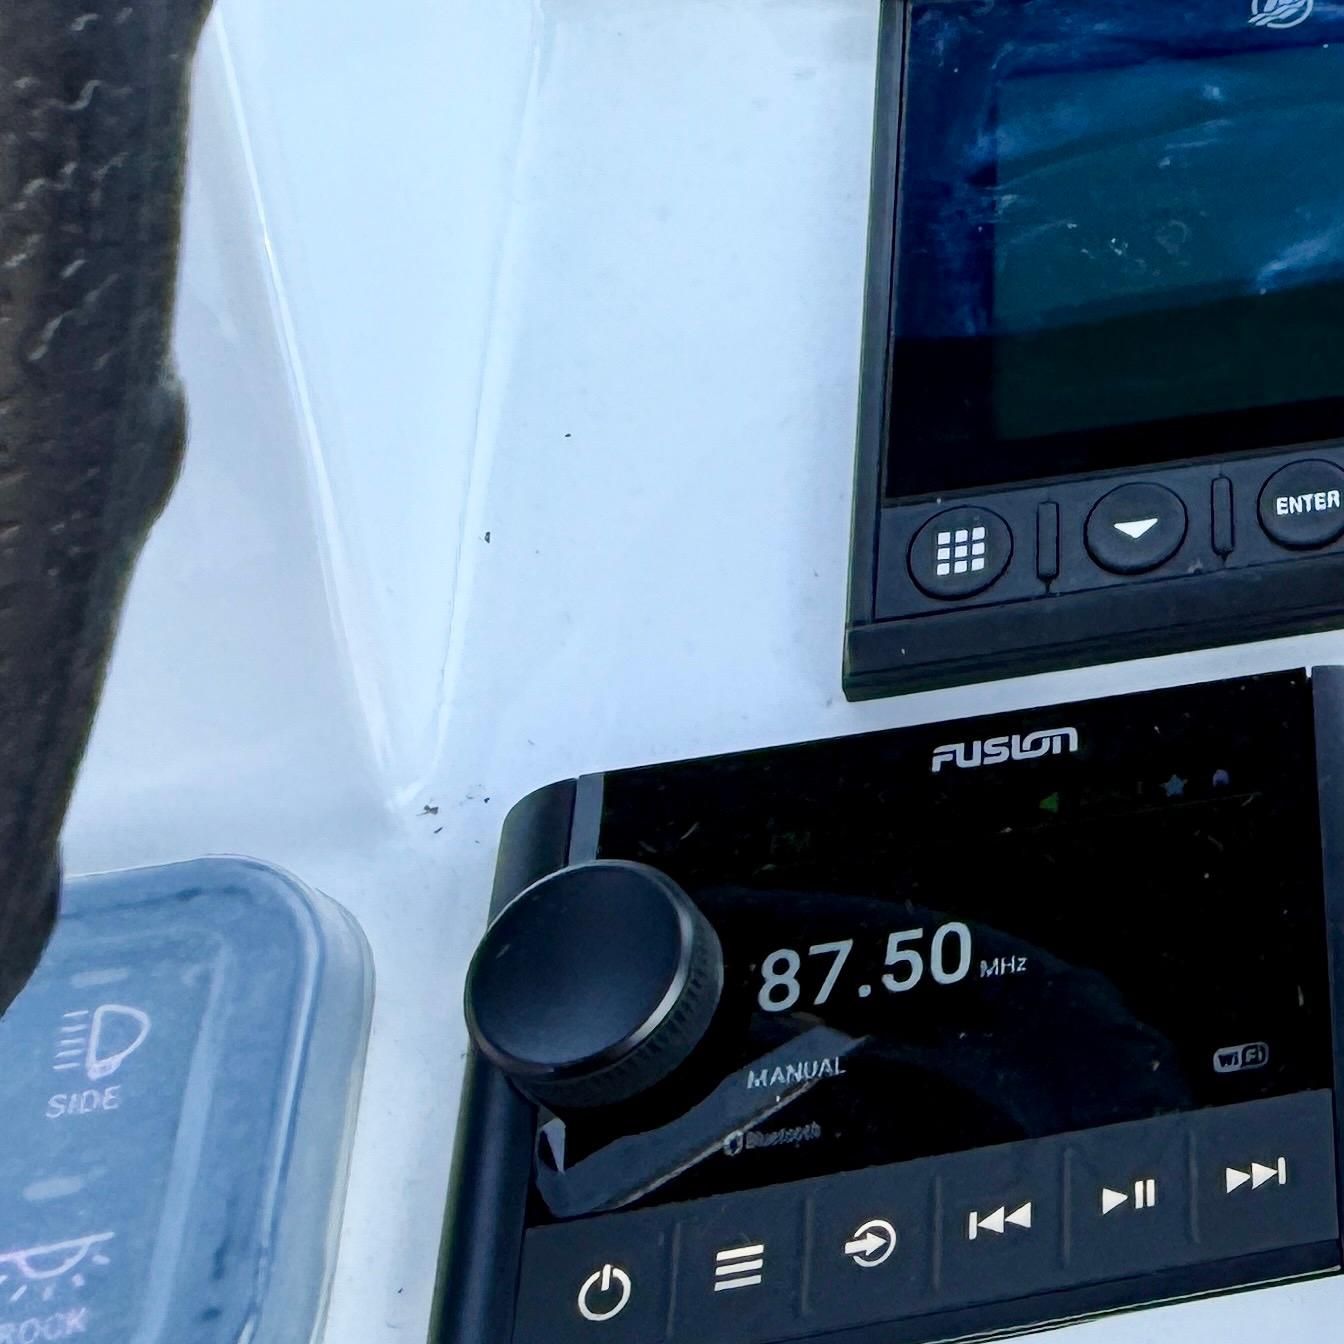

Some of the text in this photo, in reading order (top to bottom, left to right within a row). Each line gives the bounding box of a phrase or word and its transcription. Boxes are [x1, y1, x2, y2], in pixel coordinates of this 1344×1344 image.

[1276, 489, 1340, 515] ENTER
[931, 727, 1078, 773] FUSION
[758, 921, 1028, 1012] 87.50 MHz
[747, 1056, 846, 1089] MANUAL
[46, 1086, 120, 1119] SIDE
